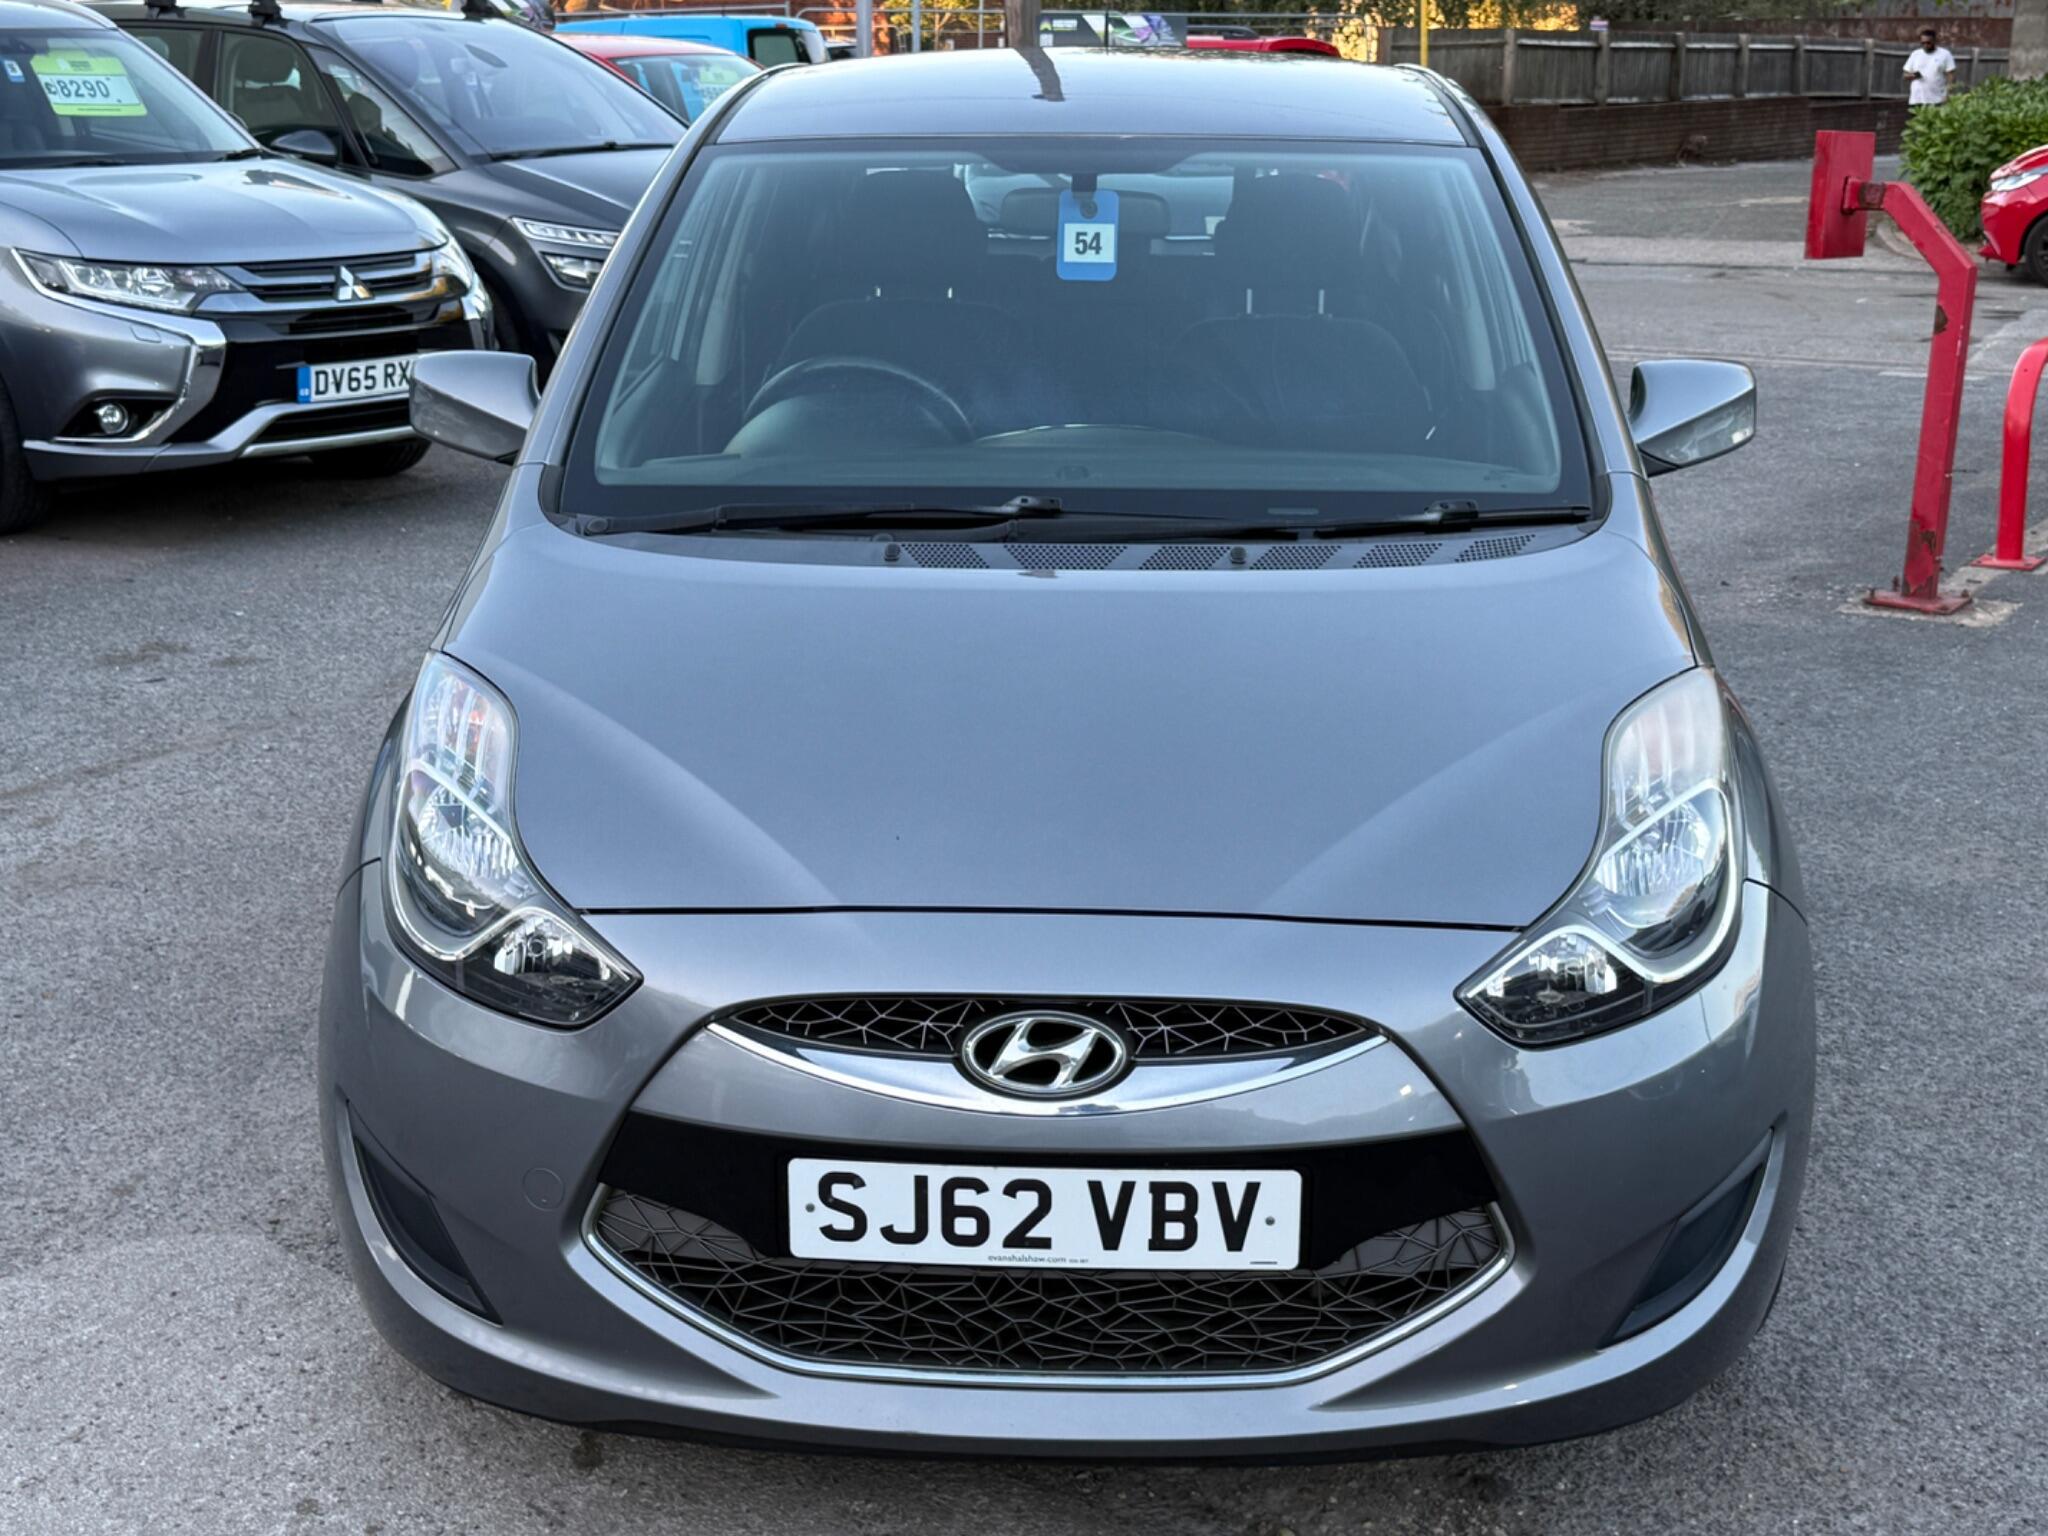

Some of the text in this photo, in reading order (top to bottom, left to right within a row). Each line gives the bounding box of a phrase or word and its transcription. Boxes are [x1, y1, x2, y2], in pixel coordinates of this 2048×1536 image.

[1074, 231, 1102, 255] 54
[314, 360, 410, 396] DV65 RX
[817, 1171, 1262, 1252] SJ62 VBV
